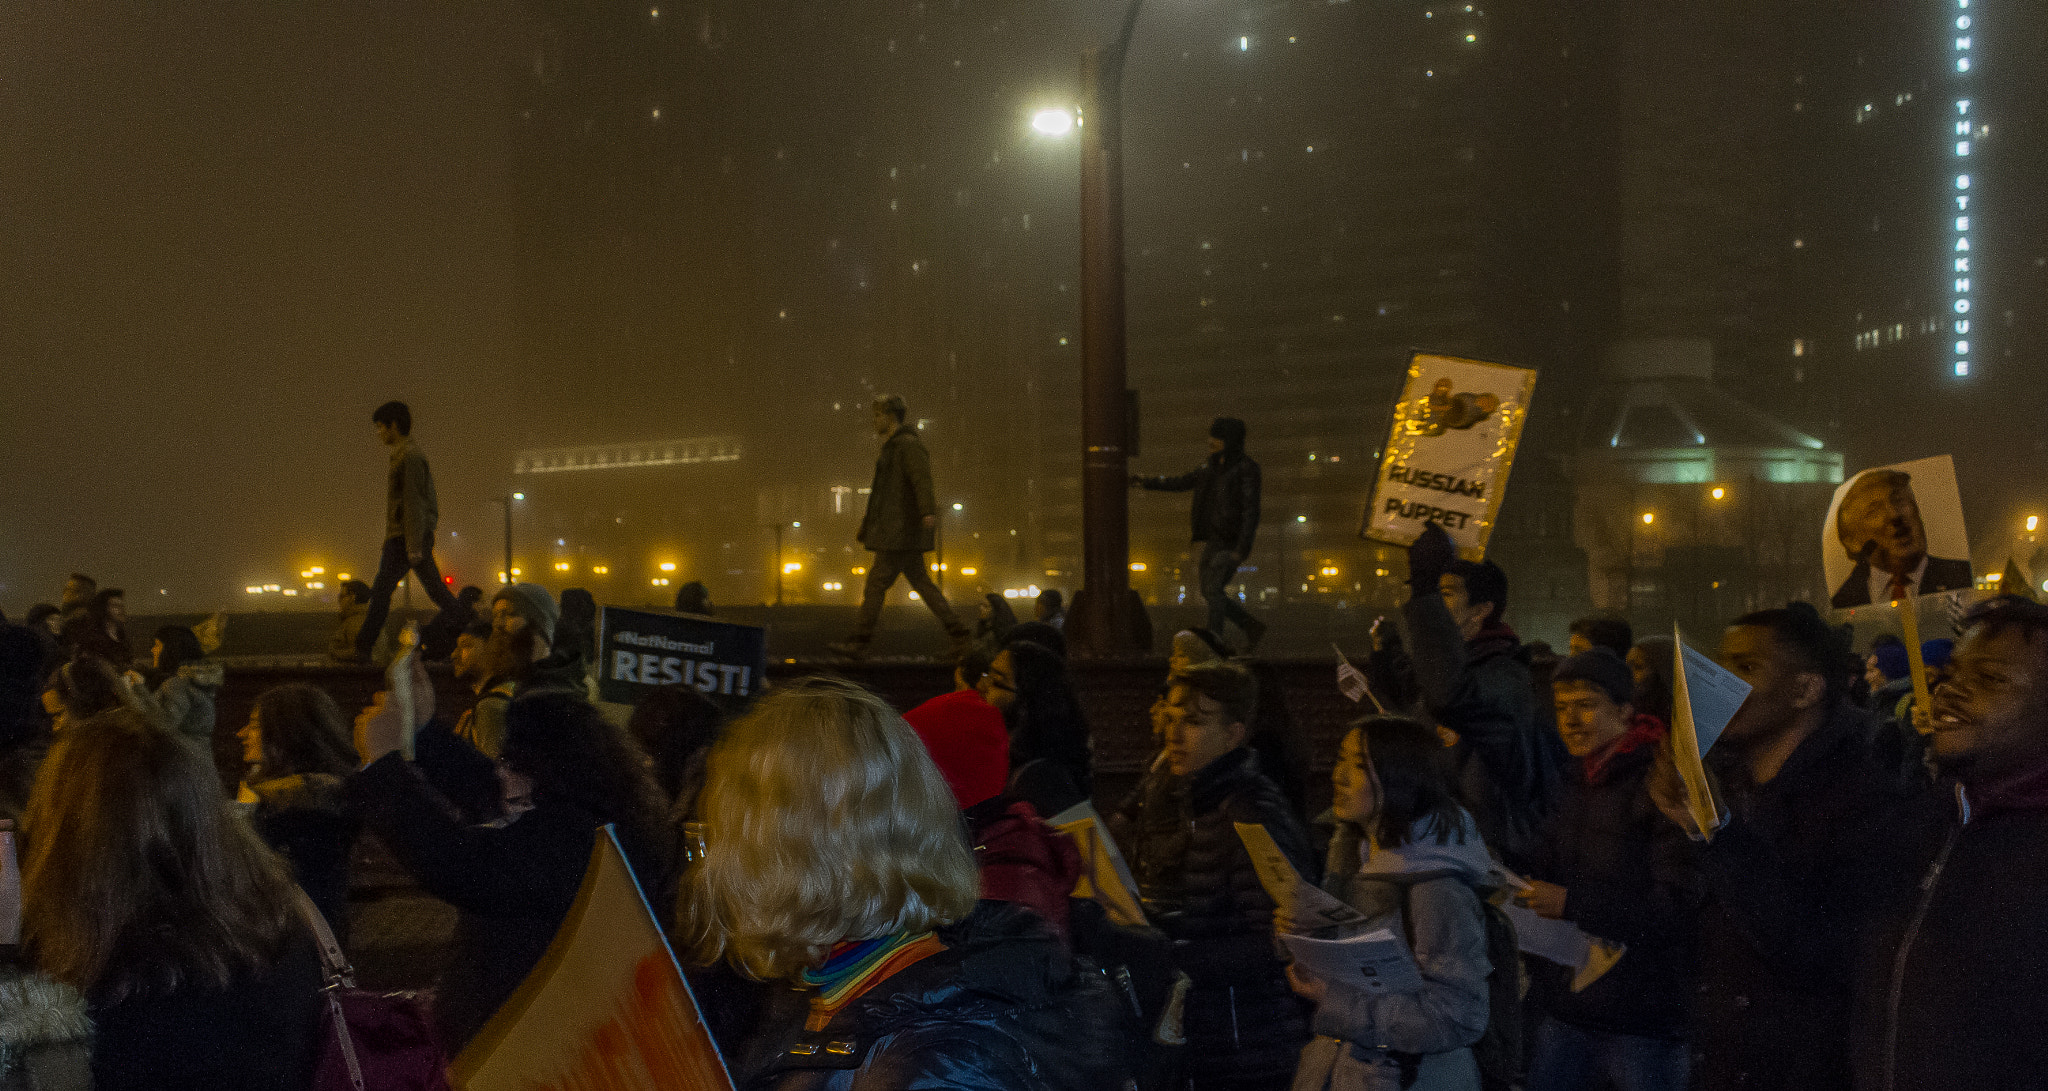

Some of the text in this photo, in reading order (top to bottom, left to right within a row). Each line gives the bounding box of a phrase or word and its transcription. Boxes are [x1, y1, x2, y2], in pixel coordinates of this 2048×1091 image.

[1955, 100, 1971, 156] THE
[1954, 174, 1971, 376] STEAKHOUSE
[1389, 465, 1486, 498] RUSSIAN
[1384, 498, 1471, 529] PUPPET
[613, 650, 751, 696] RESIST!
